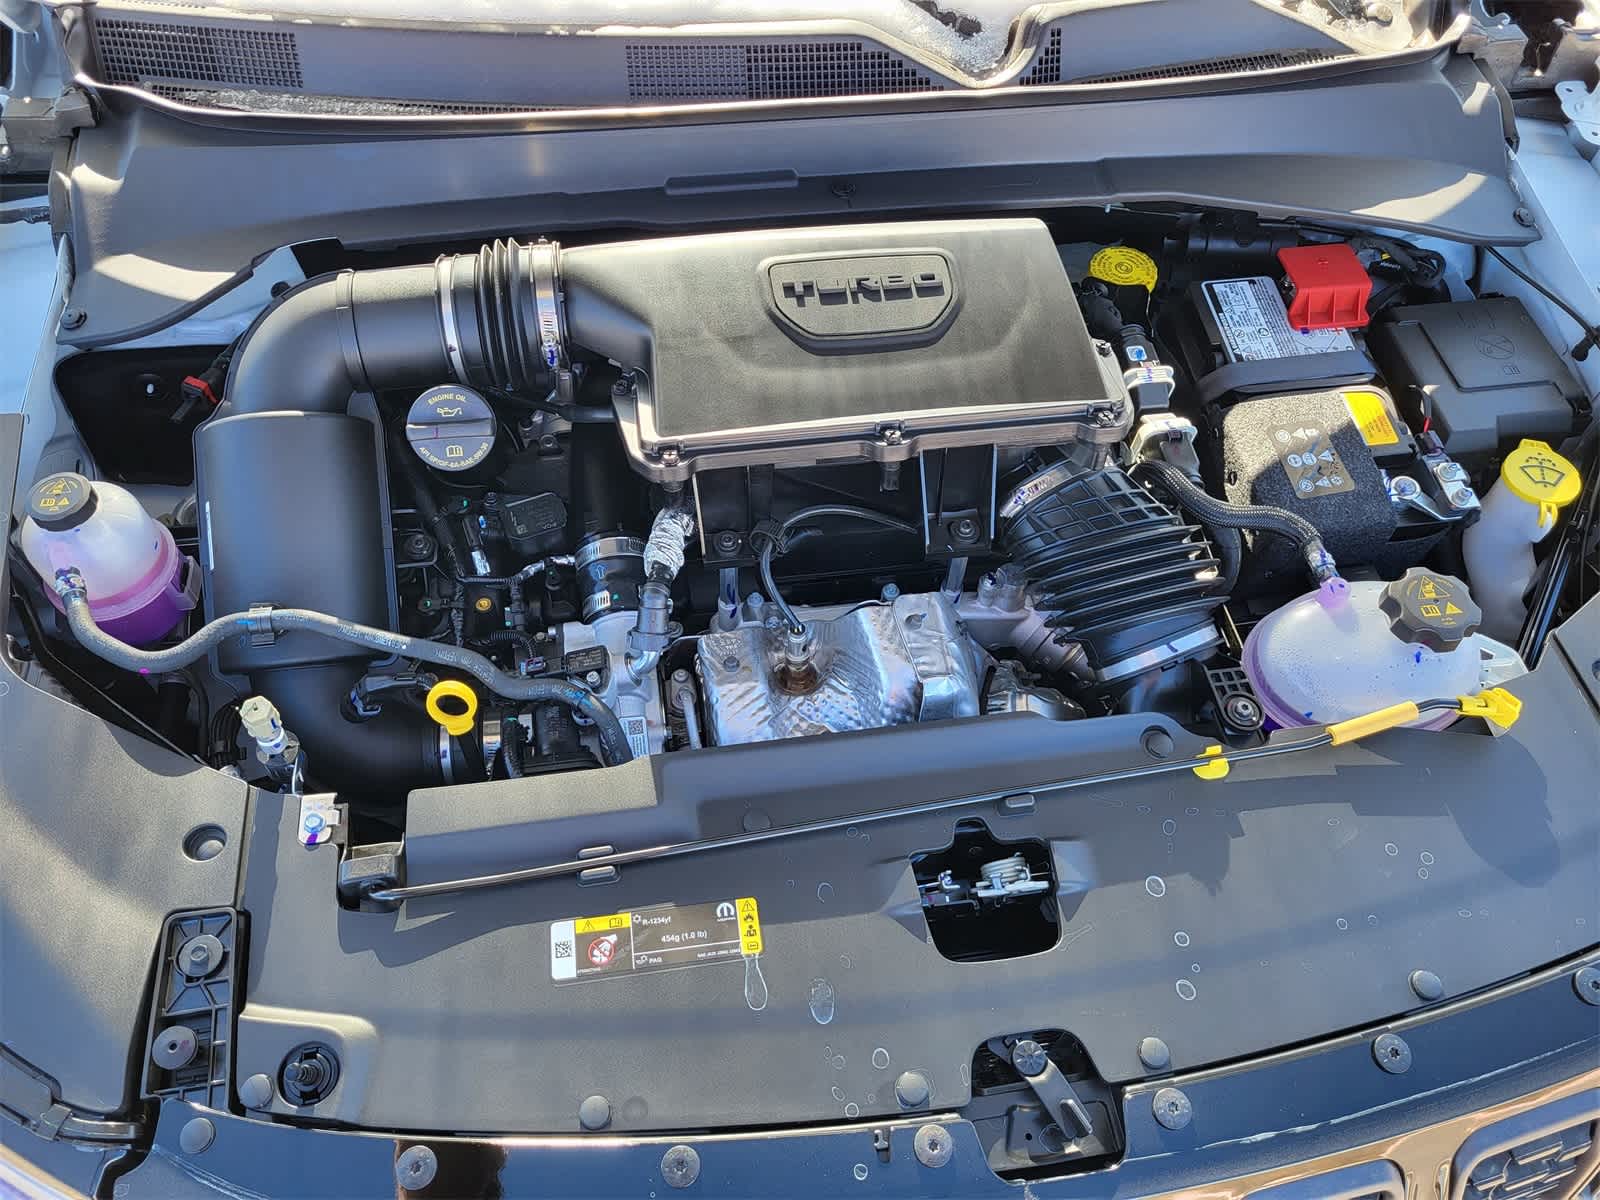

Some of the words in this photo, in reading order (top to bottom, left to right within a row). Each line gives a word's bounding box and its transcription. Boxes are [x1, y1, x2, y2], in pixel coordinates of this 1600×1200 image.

[777, 272, 945, 307] TURBO
[427, 392, 454, 405] ENGINE
[455, 393, 467, 403] OIL
[642, 915, 671, 926] R-1234yf
[661, 934, 680, 943] 454g
[681, 931, 696, 942] (1.0
[697, 929, 708, 939] lb)
